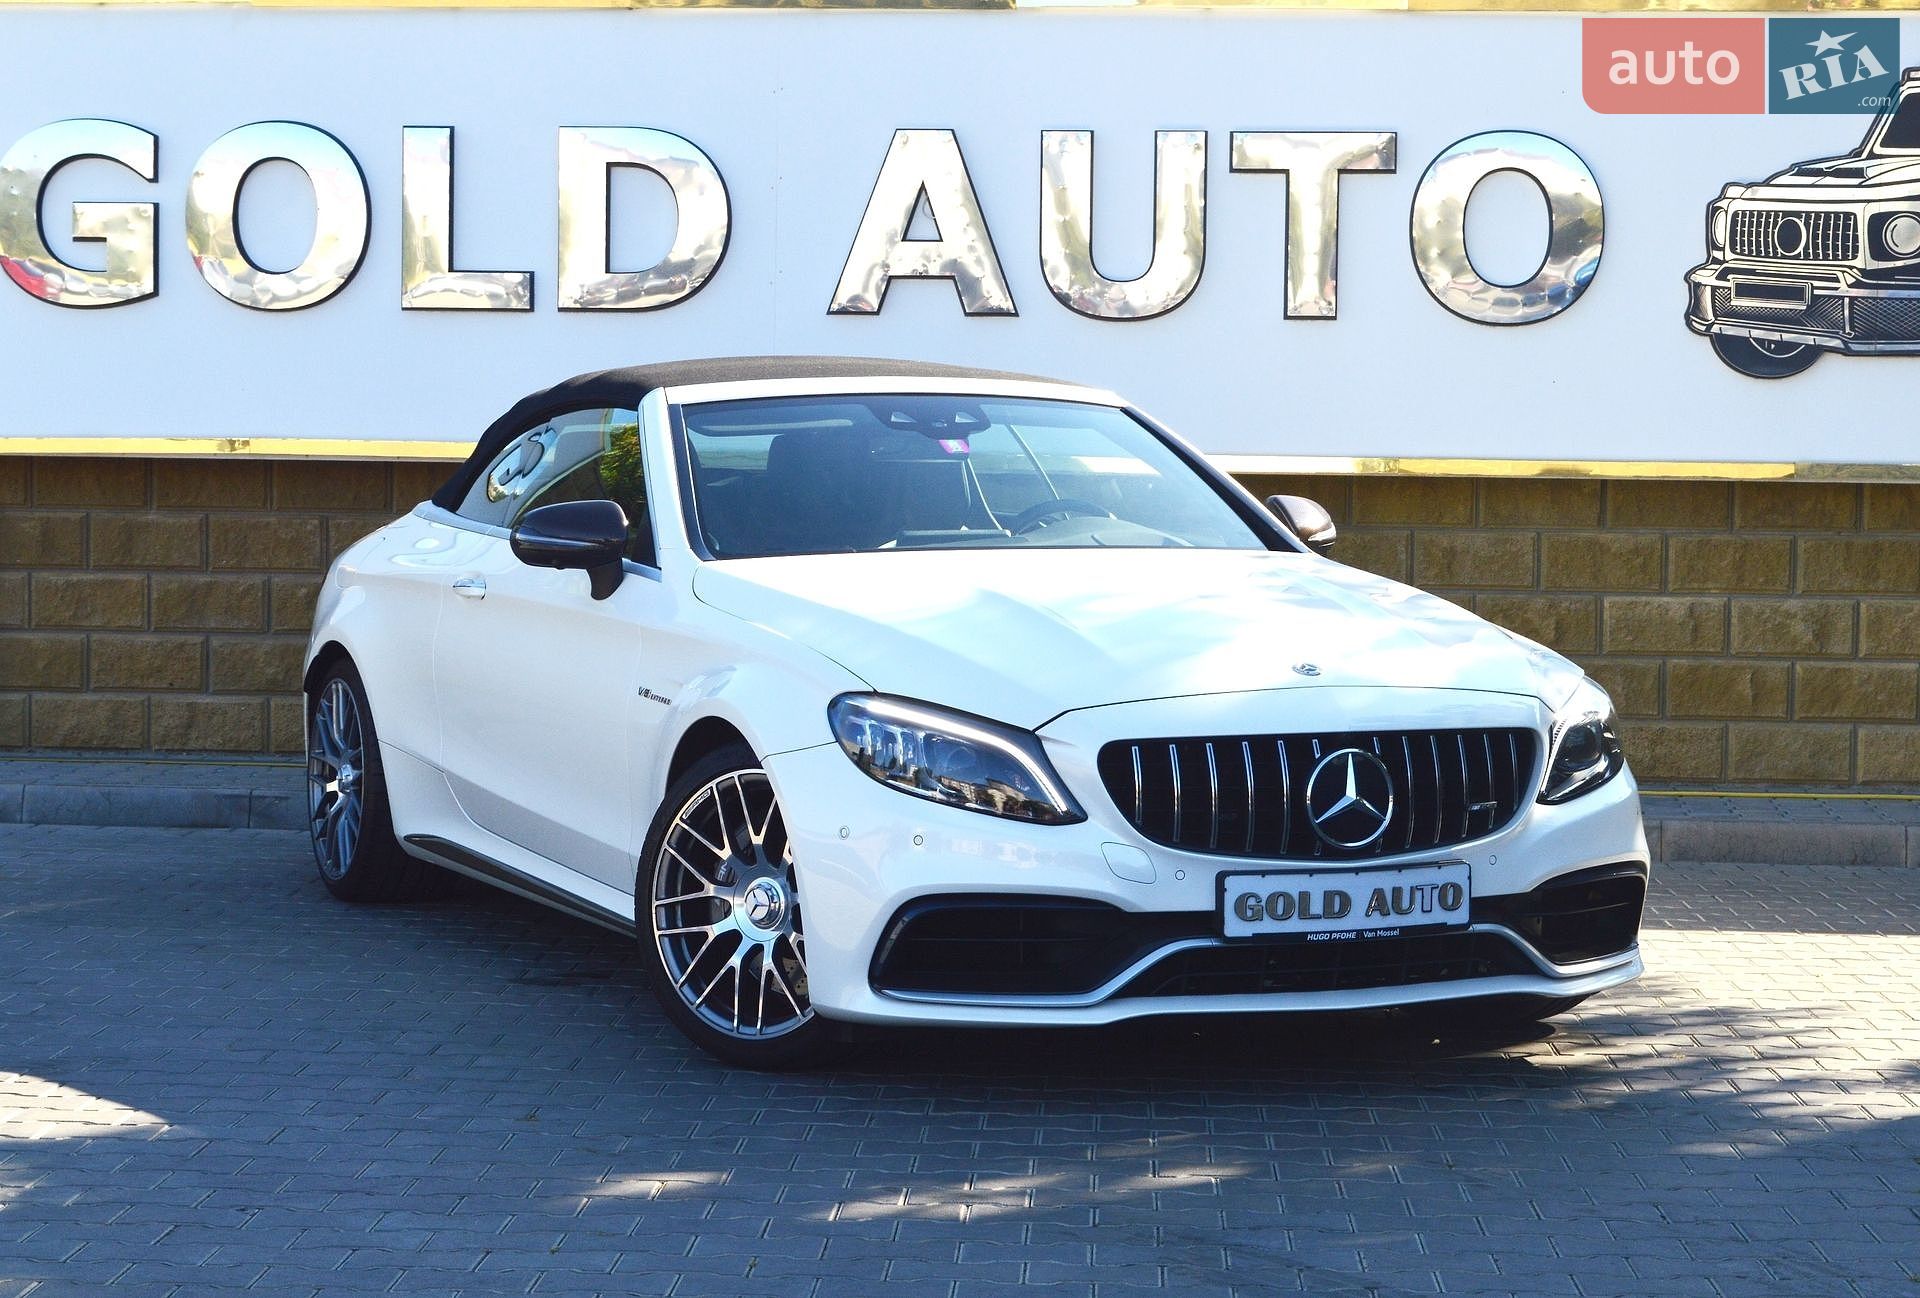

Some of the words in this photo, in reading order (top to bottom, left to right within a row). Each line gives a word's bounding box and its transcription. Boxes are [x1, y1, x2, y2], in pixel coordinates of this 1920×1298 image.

[0, 118, 734, 312] GOLD
[826, 127, 1606, 327] AUTO
[1234, 890, 1351, 922] GOLD
[1365, 882, 1464, 917] AUTO
[1307, 933, 1330, 941] HUGO
[1331, 931, 1357, 940] PFOHE
[1363, 930, 1376, 938] Van
[1377, 928, 1400, 937] Mossel
